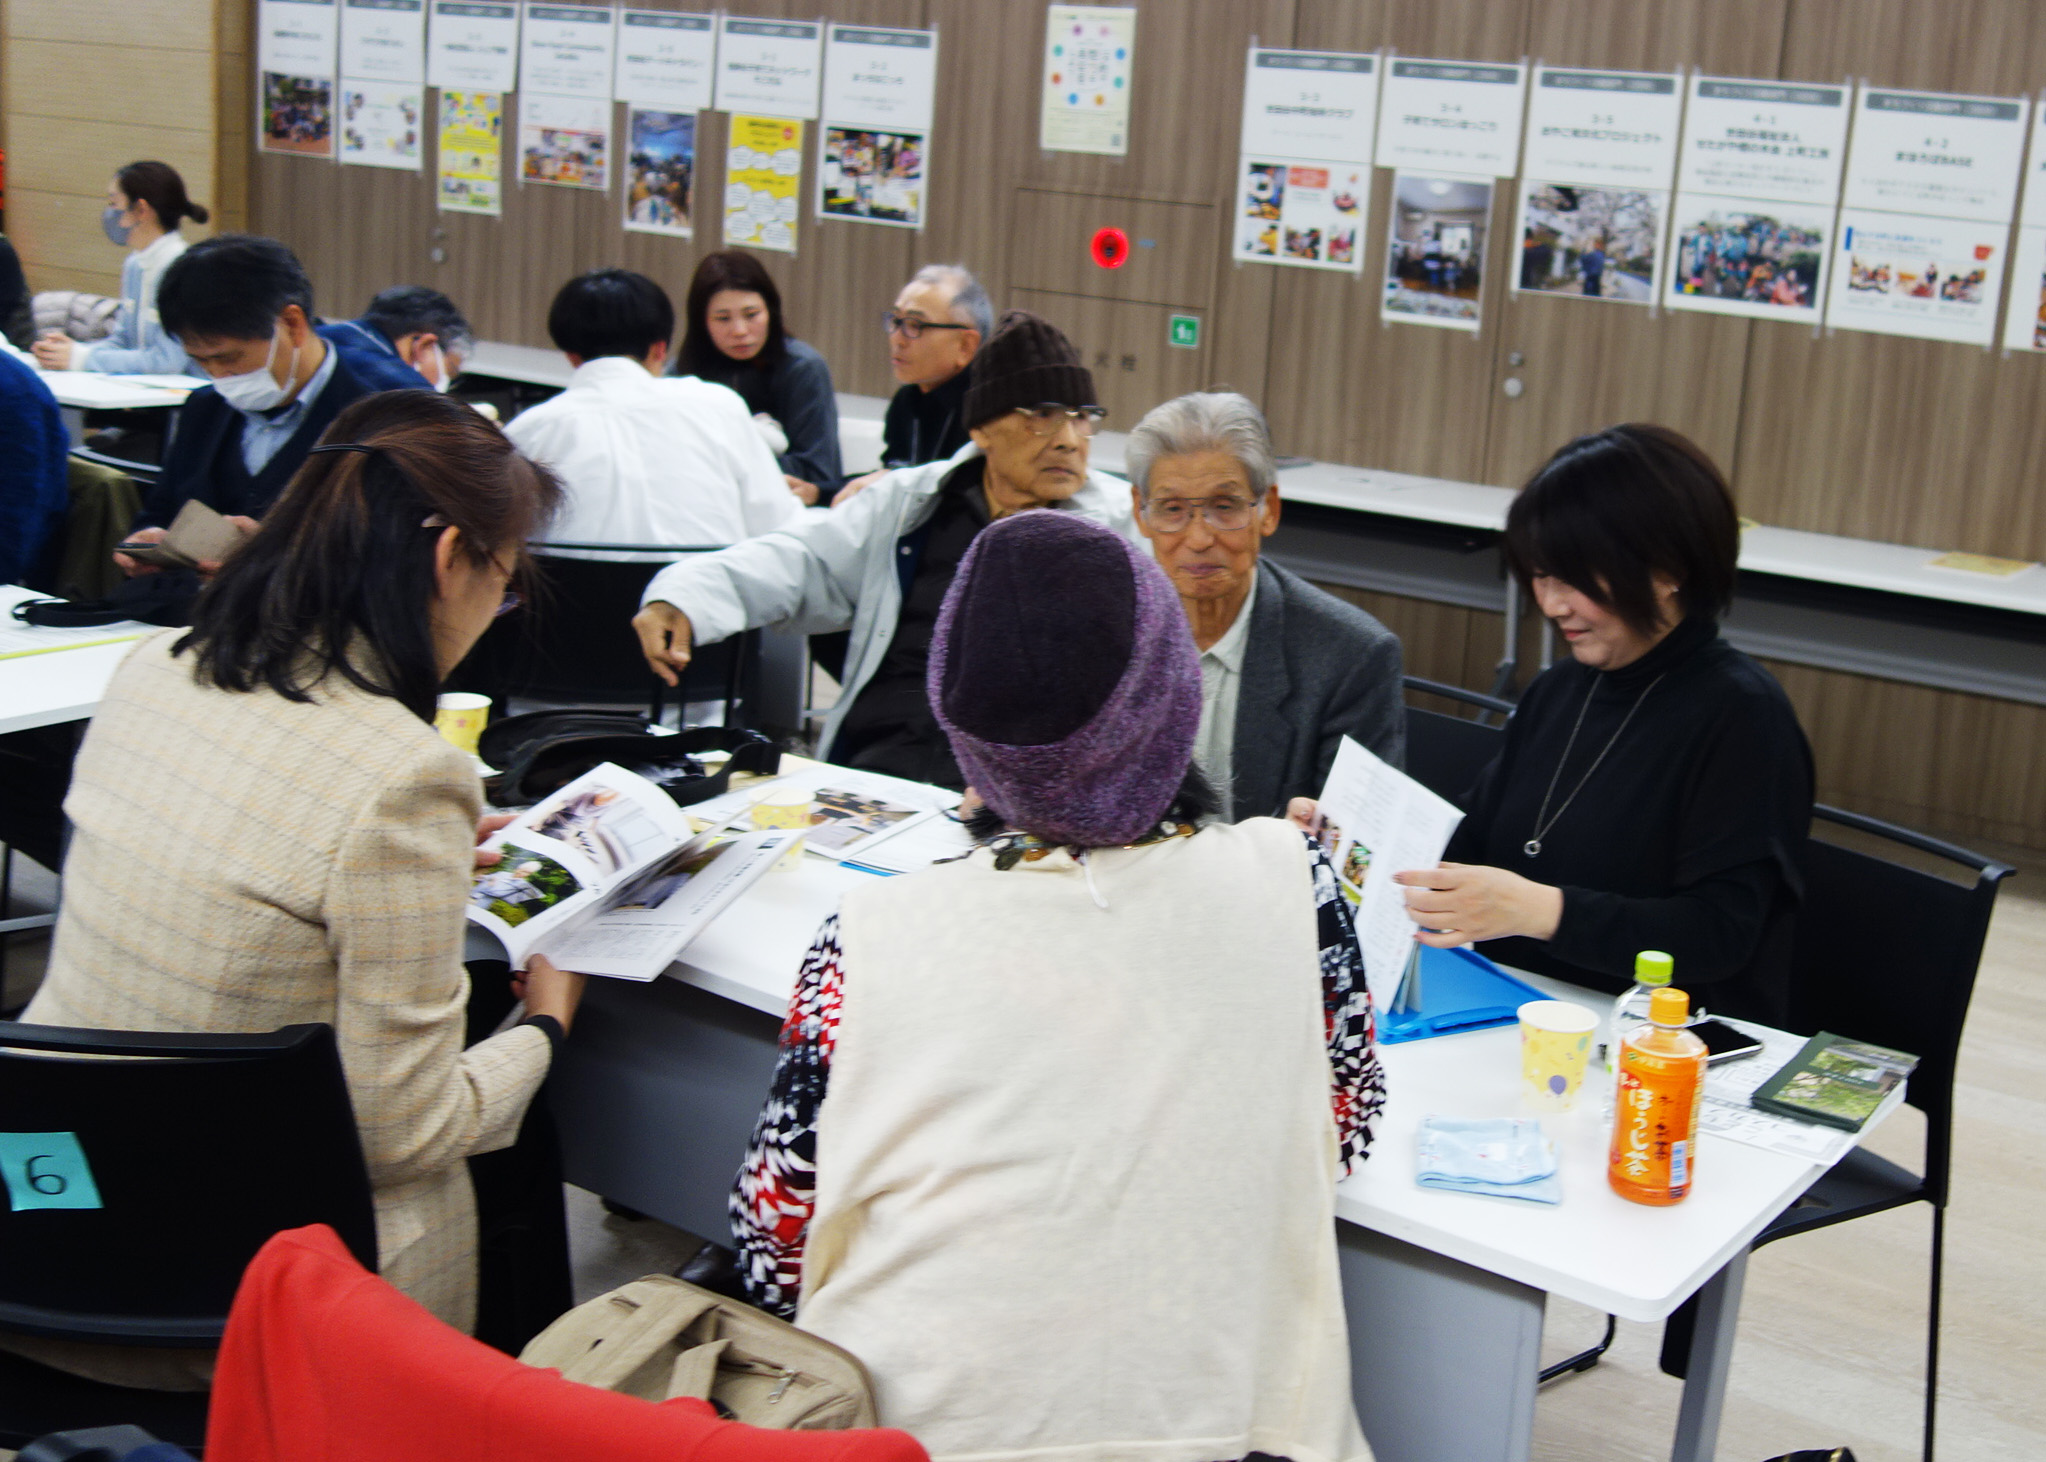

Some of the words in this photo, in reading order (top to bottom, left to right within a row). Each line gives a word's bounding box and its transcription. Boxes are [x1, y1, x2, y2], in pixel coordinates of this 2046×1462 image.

[1624, 1088, 1654, 1176] ほうじ茶
[26, 1155, 66, 1195] 6
